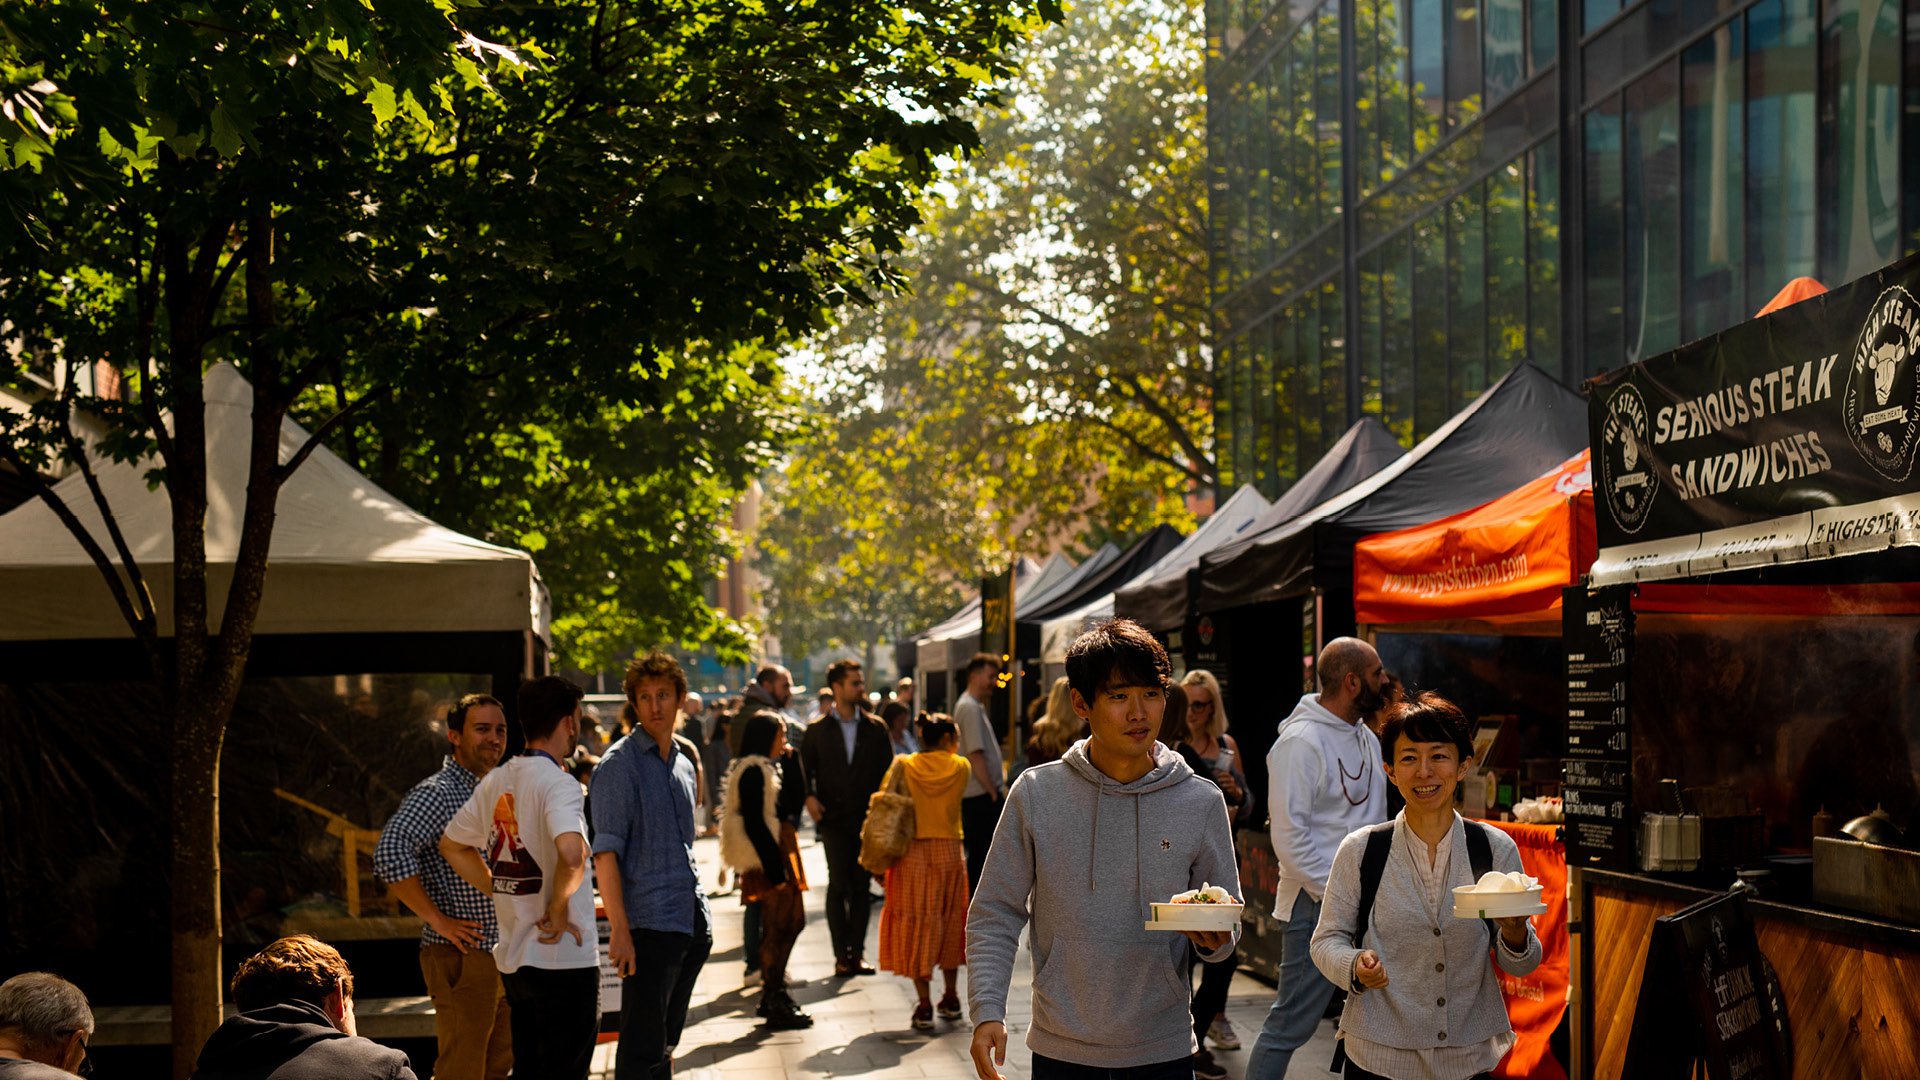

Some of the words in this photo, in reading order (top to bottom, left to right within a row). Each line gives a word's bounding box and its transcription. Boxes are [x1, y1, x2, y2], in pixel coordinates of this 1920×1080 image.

[1856, 313, 1880, 374] HIGH
[1617, 392, 1646, 439] STEAKS
[1654, 384, 1750, 445] SERIOUS
[1750, 354, 1839, 418] STEAK
[1864, 415, 1875, 426] EAT
[1875, 412, 1887, 423] SOME
[1887, 408, 1901, 419] MEAT
[1671, 430, 1832, 500] SANDWICHES
[1714, 535, 1777, 558] COLLECT
[1586, 611, 1601, 625] MENU
